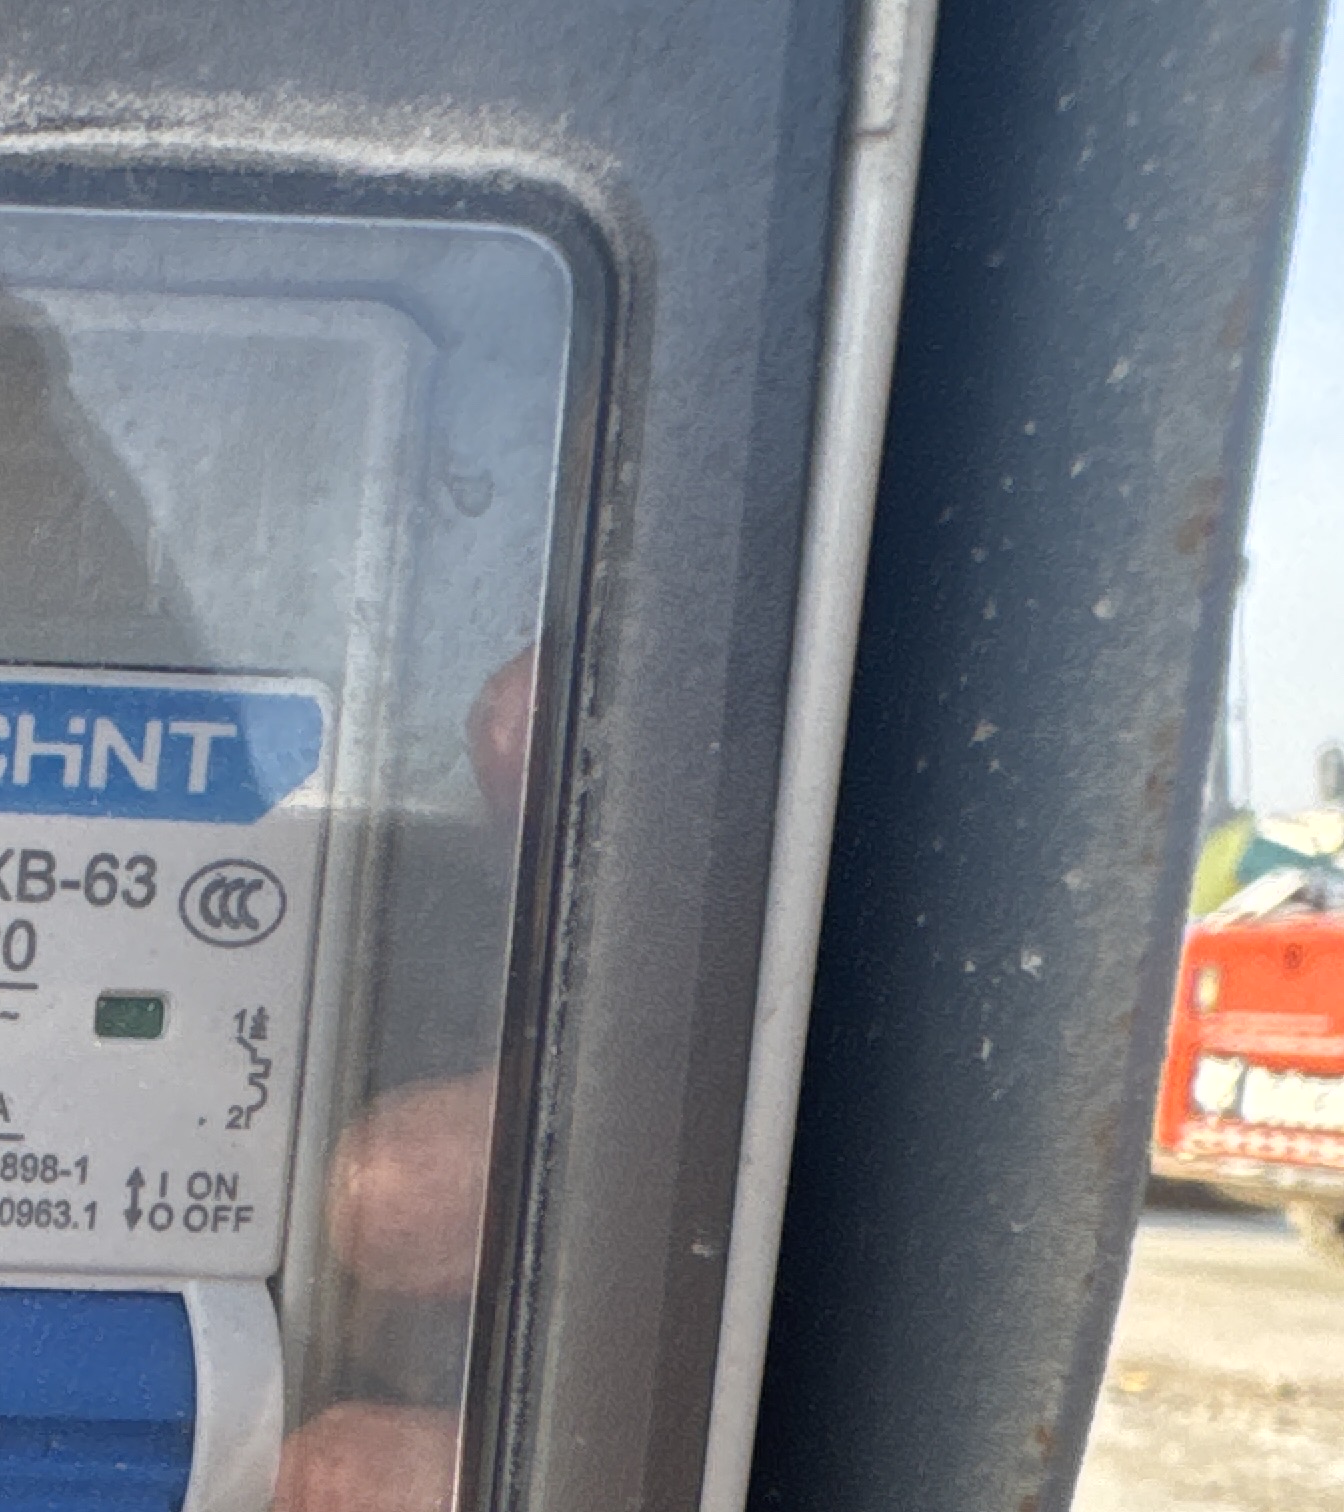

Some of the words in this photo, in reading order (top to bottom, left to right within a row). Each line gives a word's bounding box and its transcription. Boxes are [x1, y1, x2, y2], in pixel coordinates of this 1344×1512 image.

[224, 1103, 246, 1131] 2
[186, 1170, 241, 1200] ON
[181, 1203, 255, 1233] OFF
